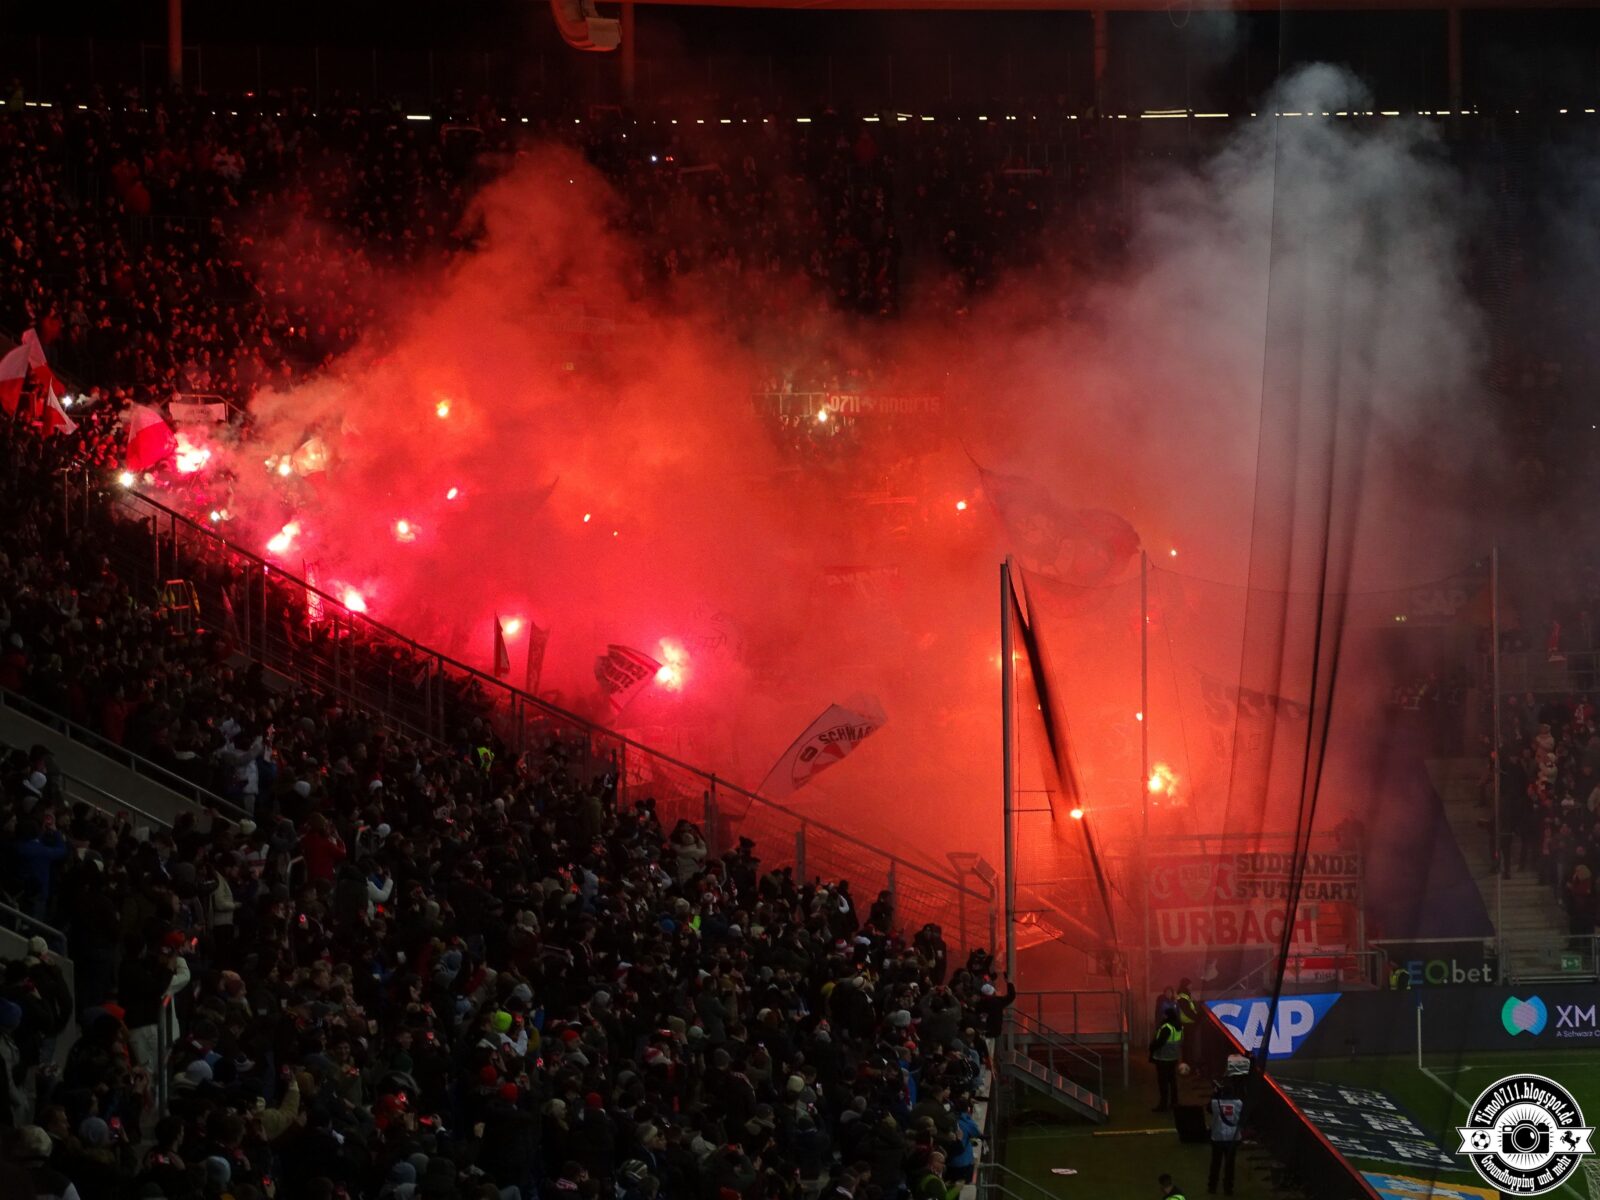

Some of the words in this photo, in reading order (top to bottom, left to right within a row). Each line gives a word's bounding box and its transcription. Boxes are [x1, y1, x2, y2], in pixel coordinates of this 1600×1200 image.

[829, 395, 860, 413] 0711
[1161, 909, 1313, 947] URBACH
[1210, 1000, 1315, 1054] SAP
[1555, 1005, 1596, 1028] XM
[1563, 1030, 1593, 1038] Schwarz
